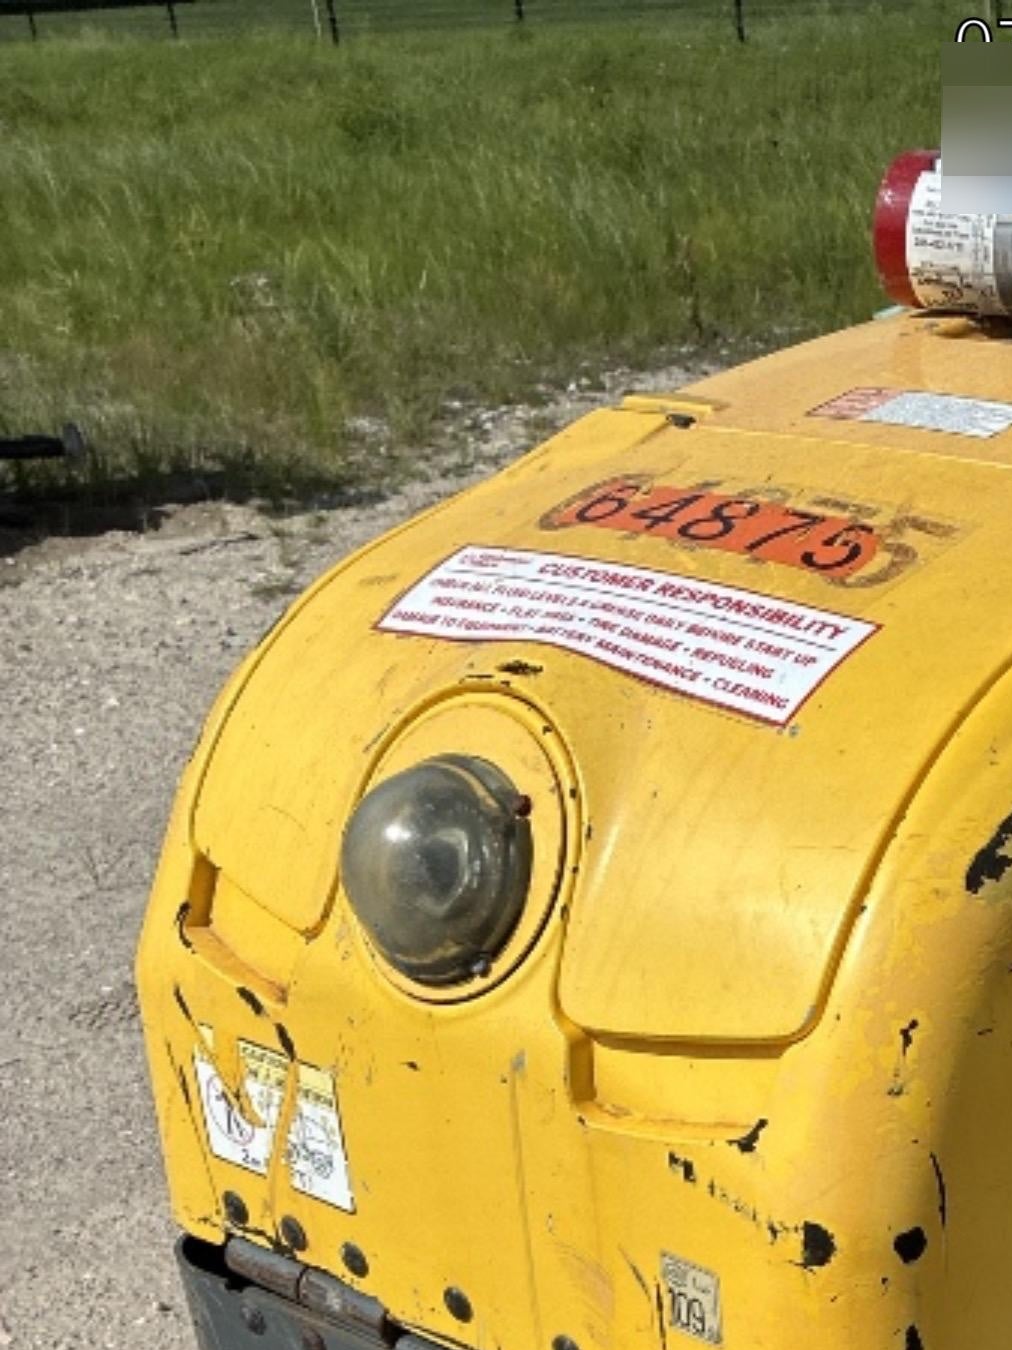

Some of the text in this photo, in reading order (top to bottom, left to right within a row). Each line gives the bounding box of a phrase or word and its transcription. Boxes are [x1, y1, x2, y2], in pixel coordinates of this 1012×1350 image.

[576, 484, 876, 570] 64875
[538, 563, 850, 639] CUSTOMER RESPONSIBILITY
[619, 627, 683, 652] DAMAGE
[690, 647, 776, 680] REFUELING
[685, 623, 745, 646] BEFORE
[743, 638, 793, 660] START
[794, 653, 818, 668] UP
[711, 677, 790, 710] CLEANING
